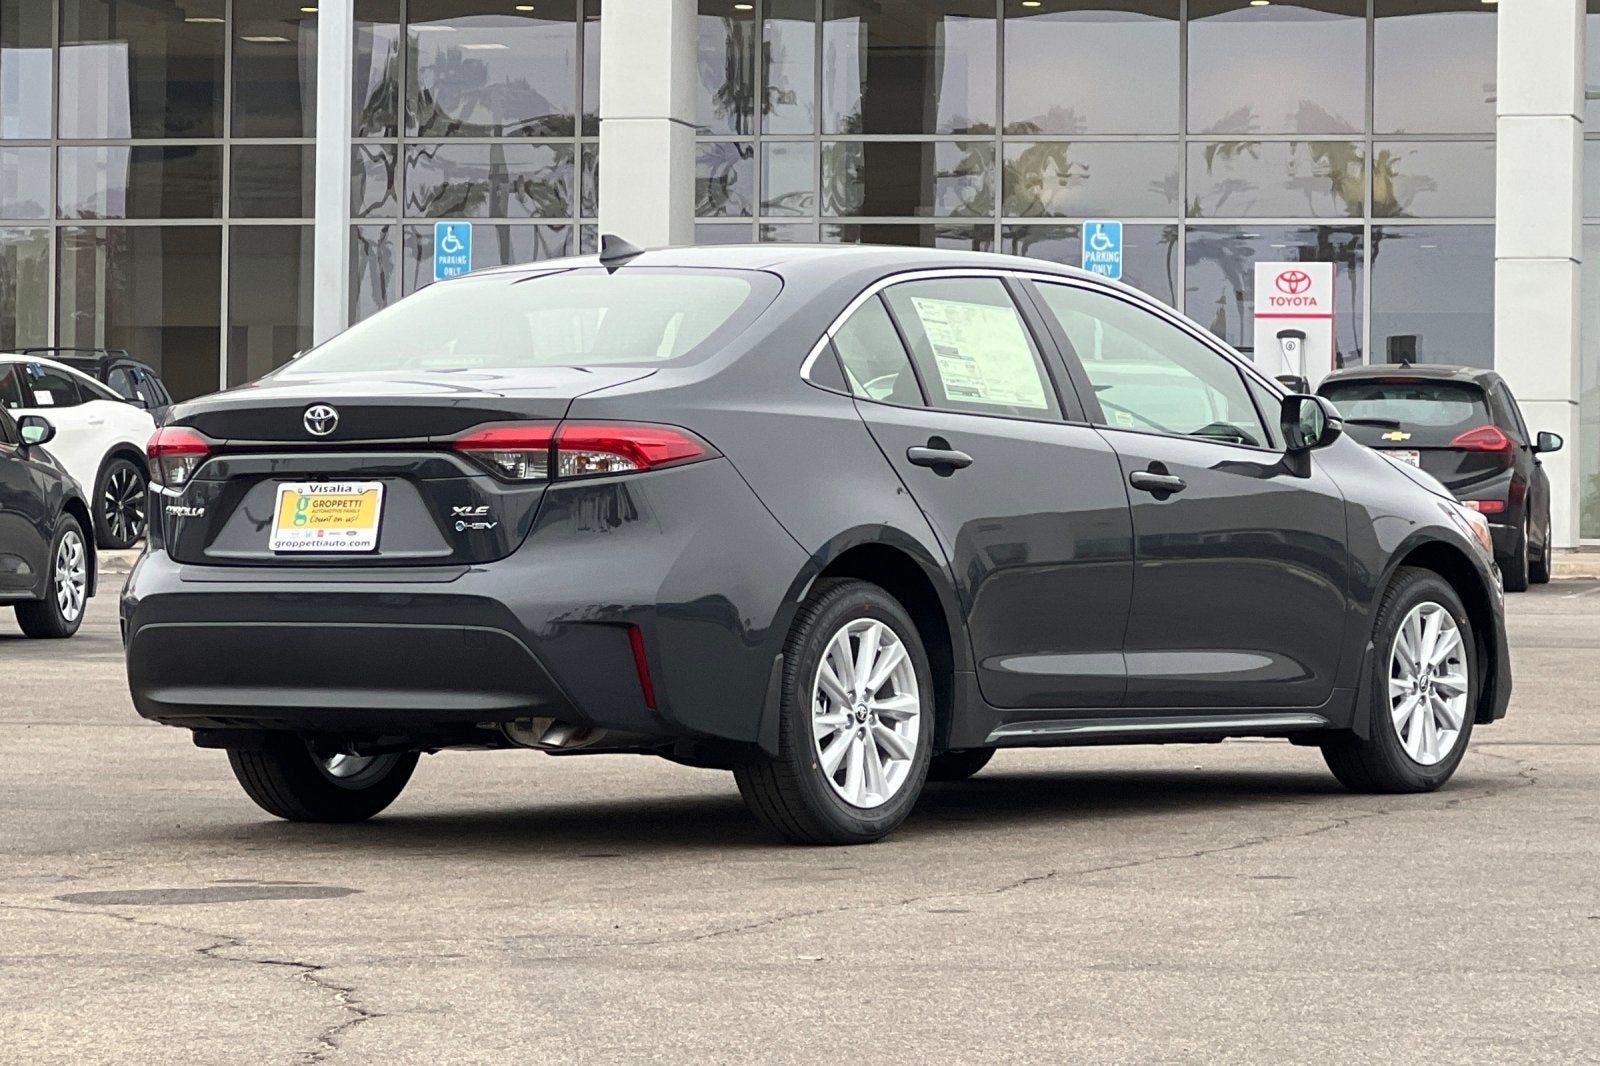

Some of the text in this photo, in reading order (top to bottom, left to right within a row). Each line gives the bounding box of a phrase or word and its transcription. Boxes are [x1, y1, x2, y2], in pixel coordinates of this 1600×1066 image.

[438, 255, 467, 265] PARKING
[1085, 251, 1119, 263] PARKING
[443, 266, 461, 276] ONLY
[1091, 263, 1113, 276] ONLY
[1269, 296, 1318, 307] TOYOTA
[309, 484, 353, 493] Visalia
[312, 499, 363, 508] GROPPETTI
[450, 505, 490, 517] XLE
[274, 540, 371, 549] groppettiauto.com
